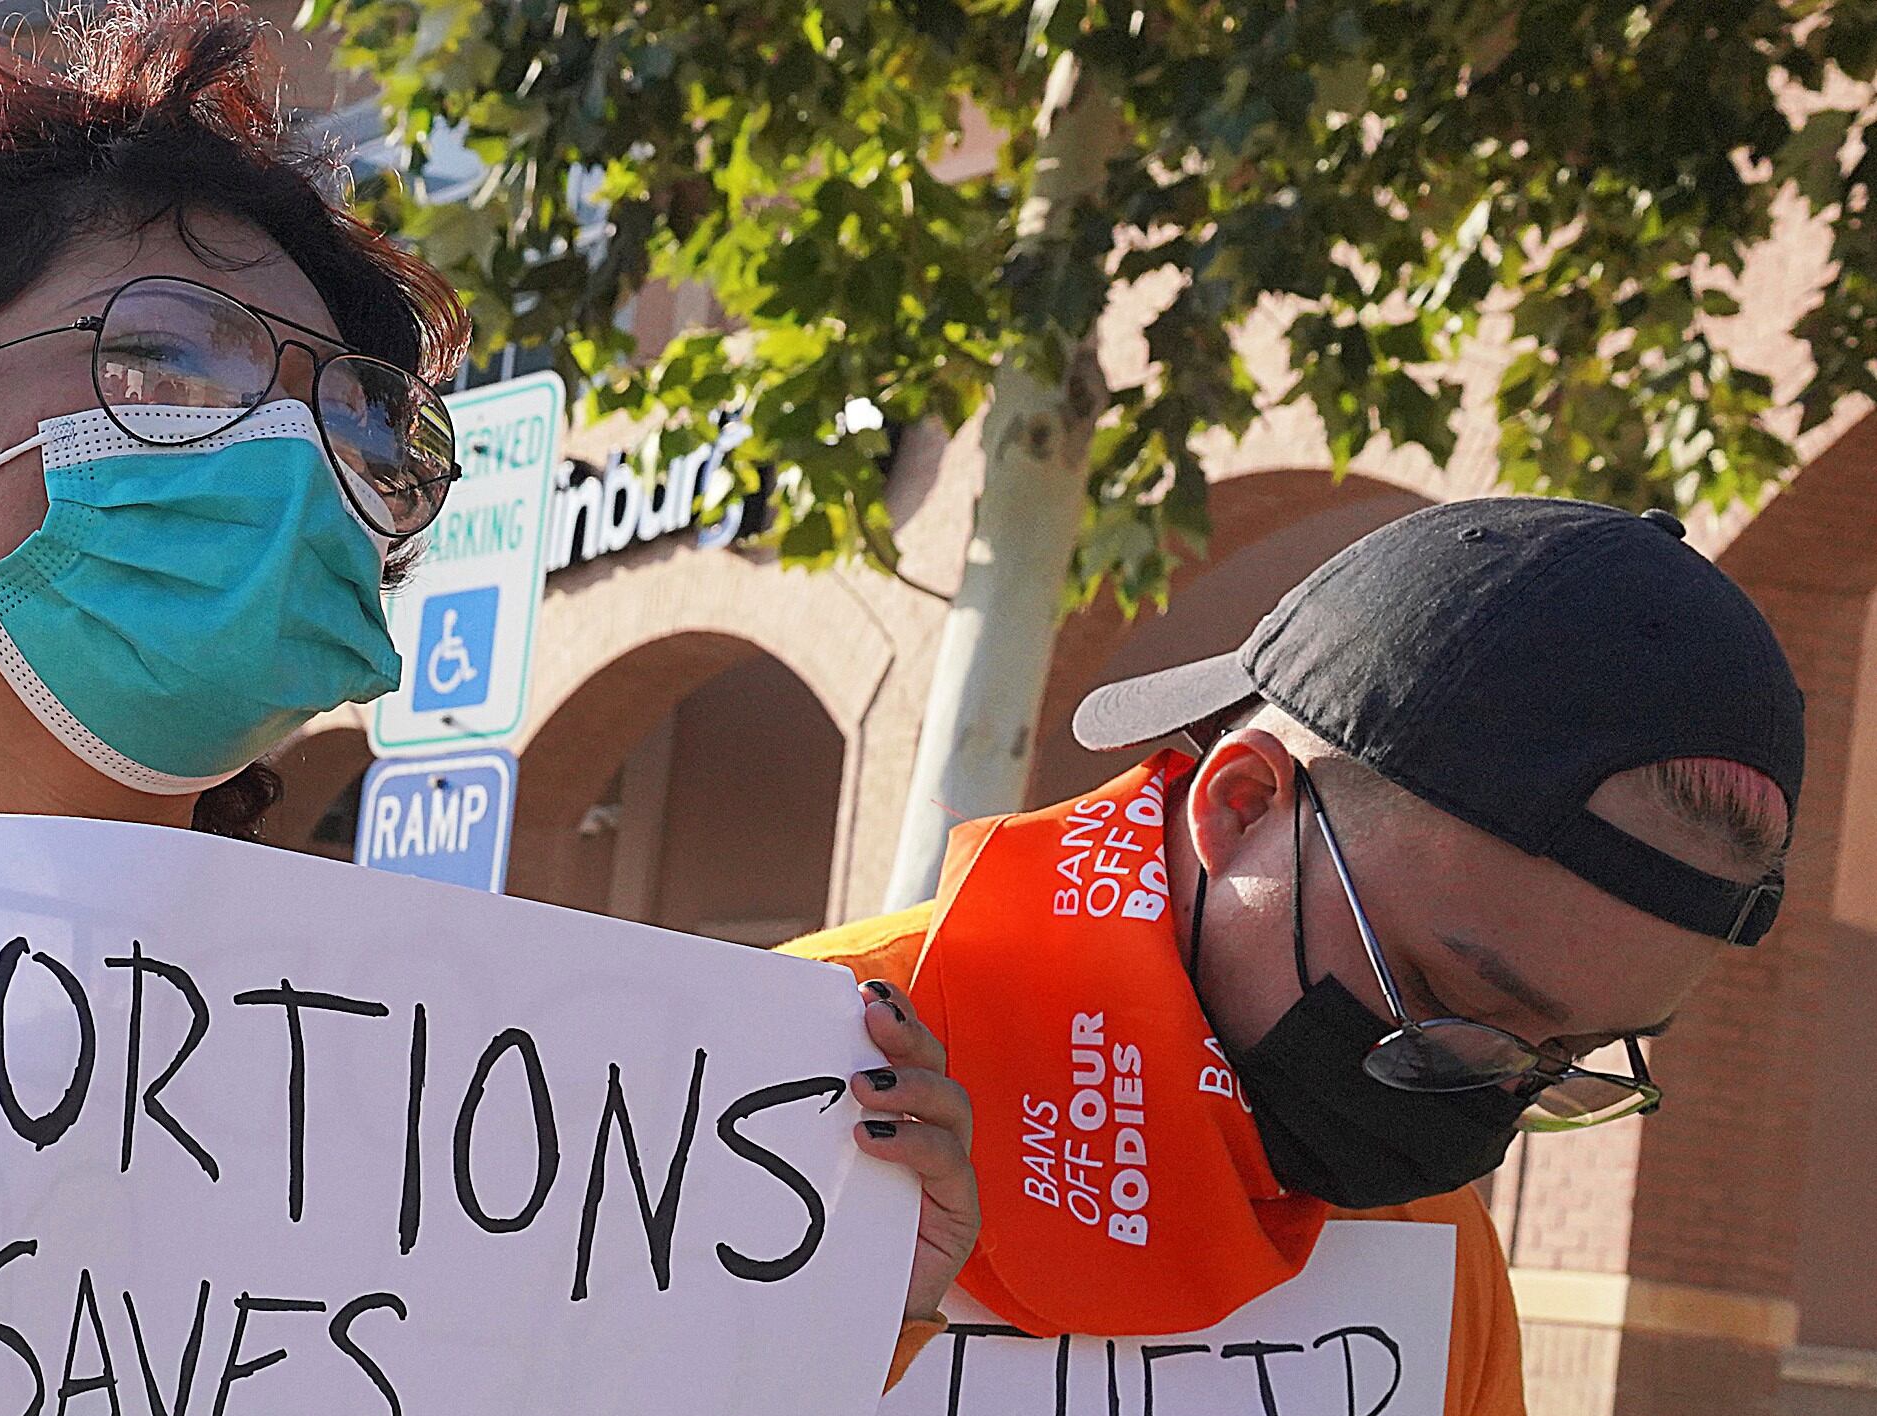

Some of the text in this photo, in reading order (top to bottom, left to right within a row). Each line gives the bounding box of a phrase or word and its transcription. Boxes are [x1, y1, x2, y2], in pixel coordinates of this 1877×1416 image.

[457, 415, 544, 480] ERVED
[425, 498, 524, 562] ARKING
[373, 784, 489, 860] RAMP
[1053, 799, 1117, 916] BANS
[1085, 826, 1144, 918] OFF
[1022, 1094, 1060, 1208] BANS
[1064, 1011, 1107, 1225] OFF OUR
[1108, 1042, 1150, 1246] BODIES
